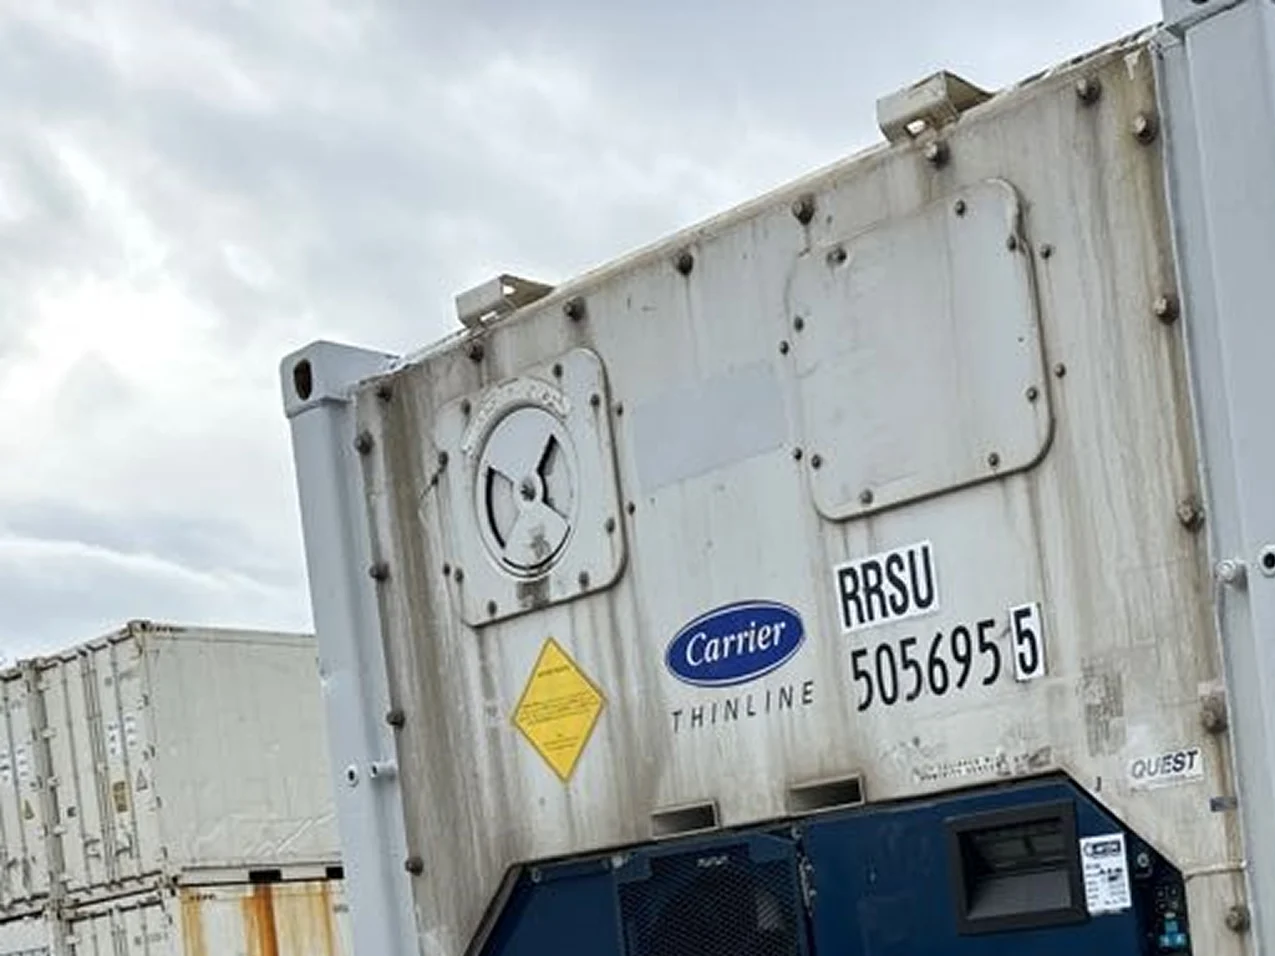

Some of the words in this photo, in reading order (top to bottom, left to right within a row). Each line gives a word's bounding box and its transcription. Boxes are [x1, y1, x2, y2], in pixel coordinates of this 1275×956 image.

[838, 545, 935, 628] RRSU
[685, 620, 787, 667] Carrier
[850, 618, 1002, 713] 505695
[1012, 607, 1039, 675] 5
[671, 680, 814, 733] THINLINE
[1131, 749, 1199, 780] QUEST
